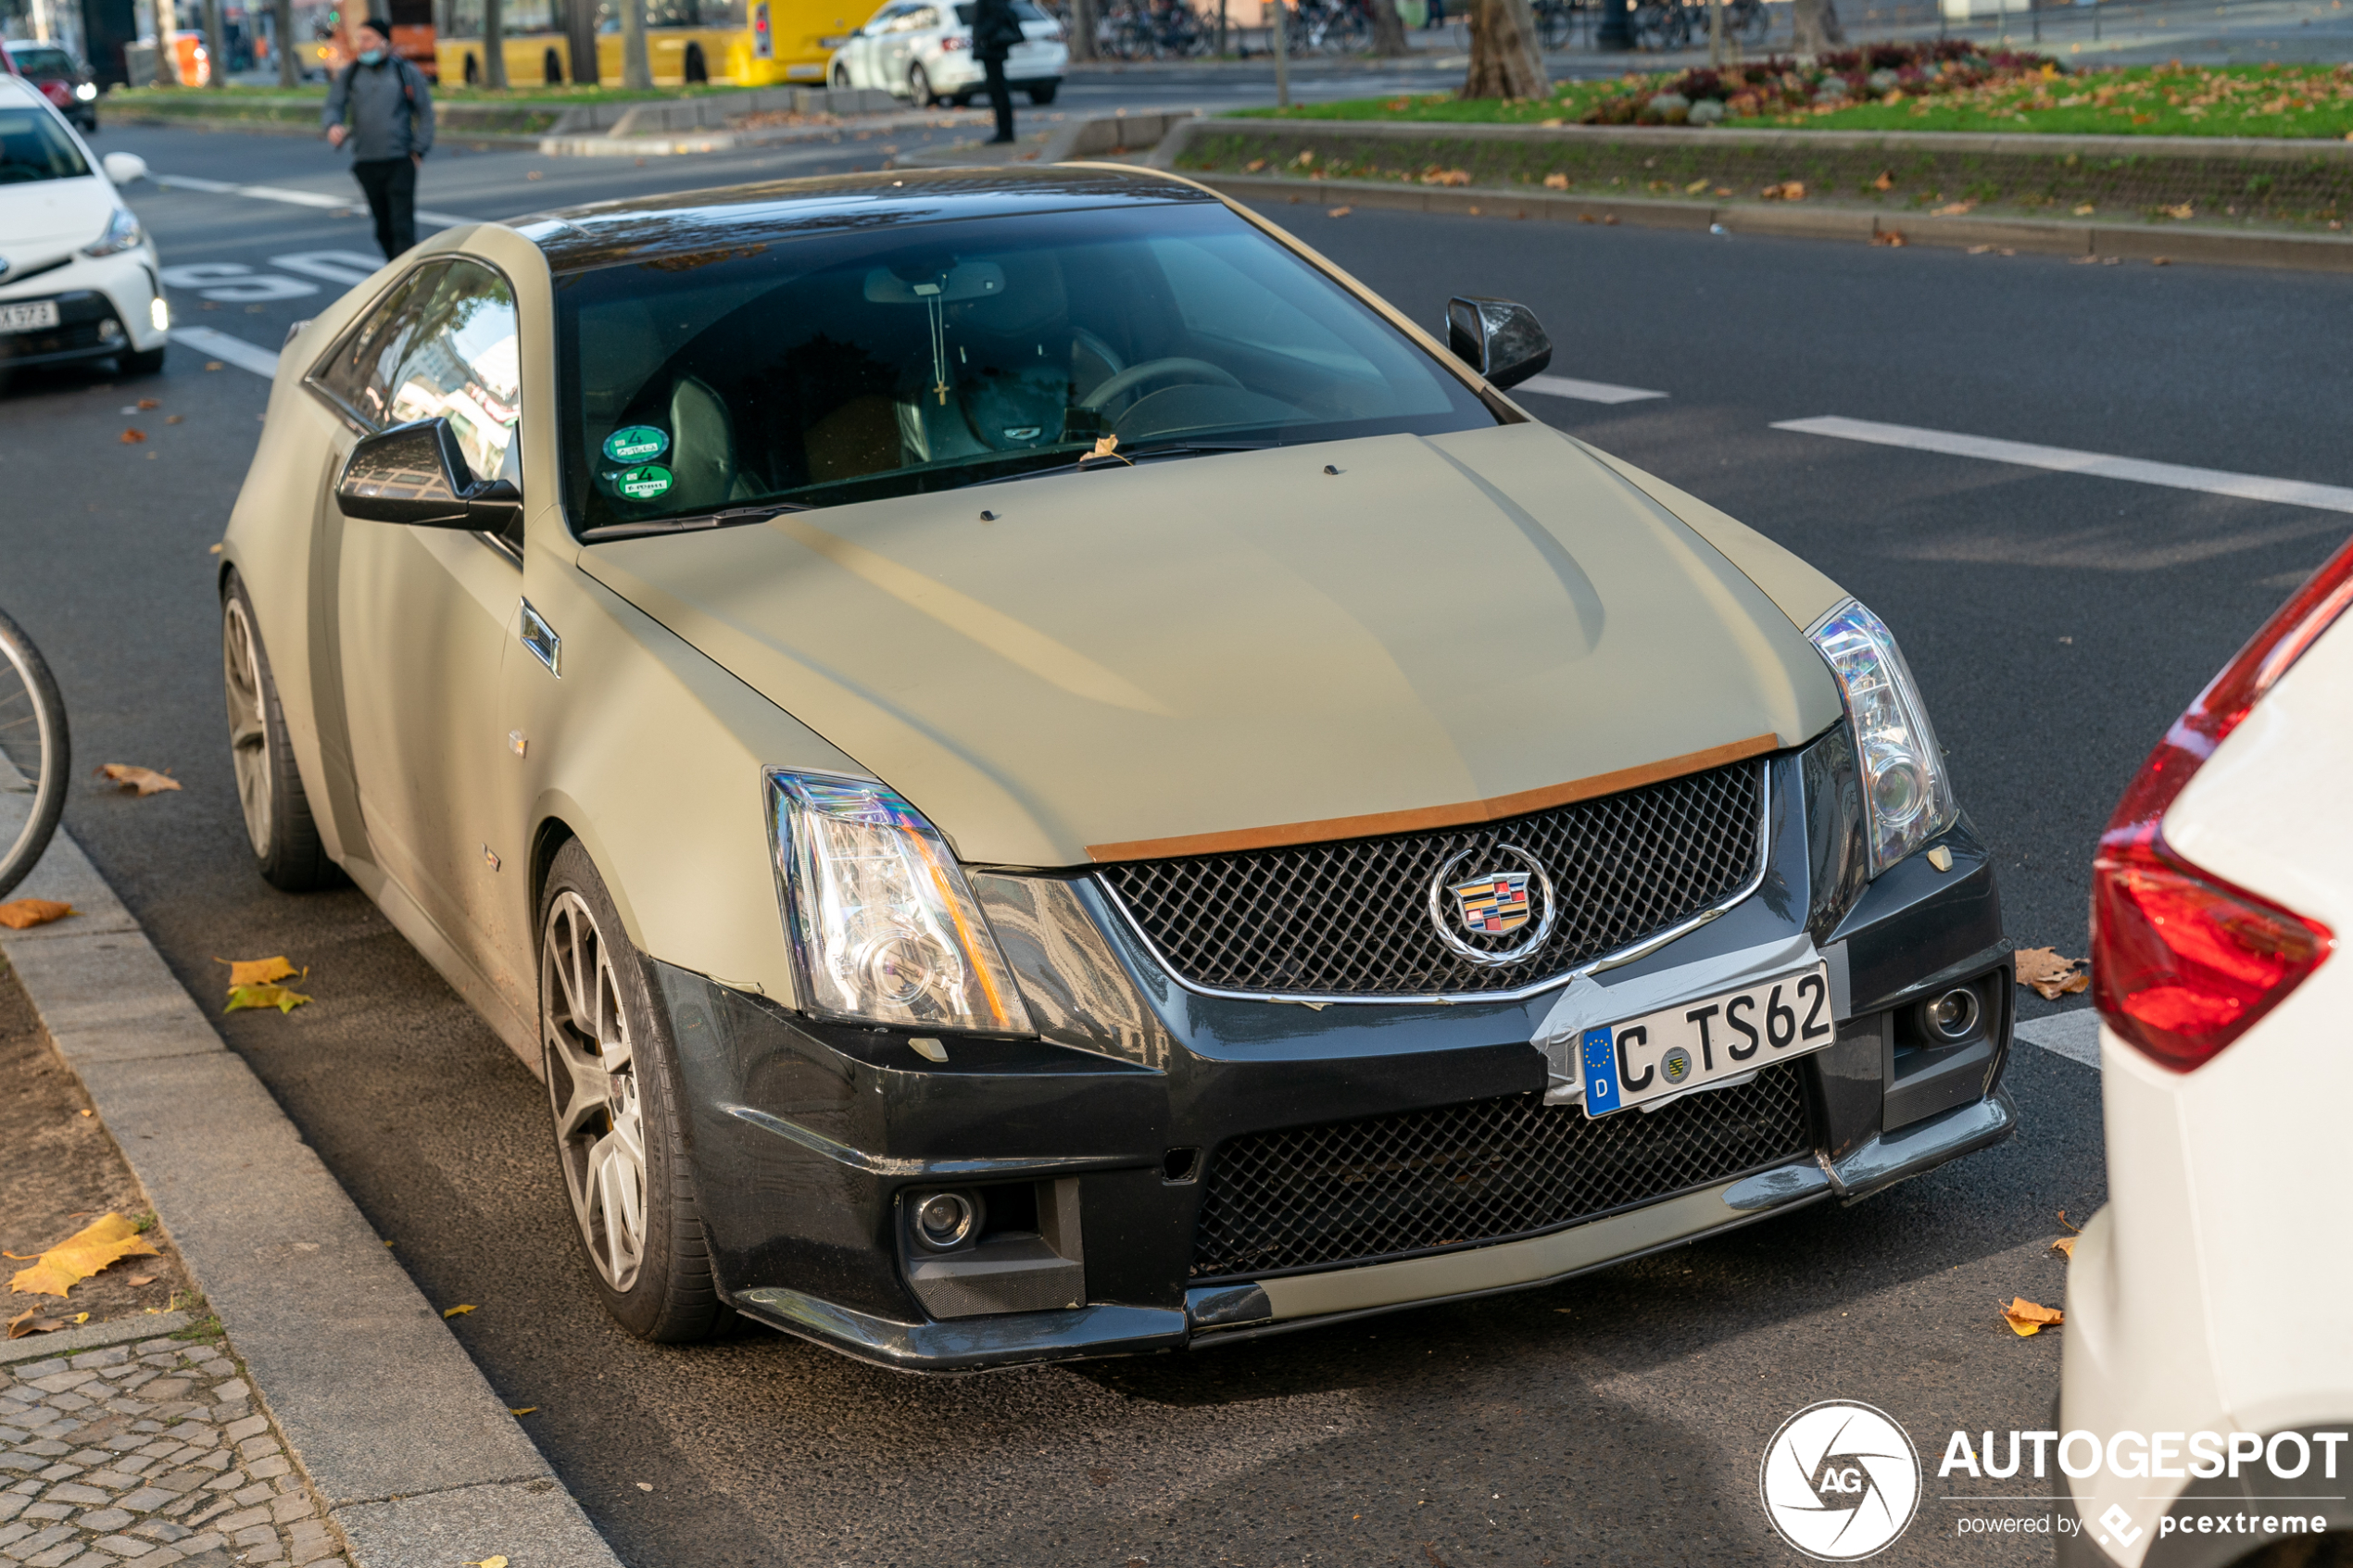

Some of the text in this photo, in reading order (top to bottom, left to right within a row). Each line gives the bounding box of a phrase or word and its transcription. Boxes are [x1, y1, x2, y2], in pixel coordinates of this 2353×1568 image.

[627, 431, 644, 445] 4
[637, 467, 654, 482] 4
[1594, 972, 1831, 1098] D C TS62
